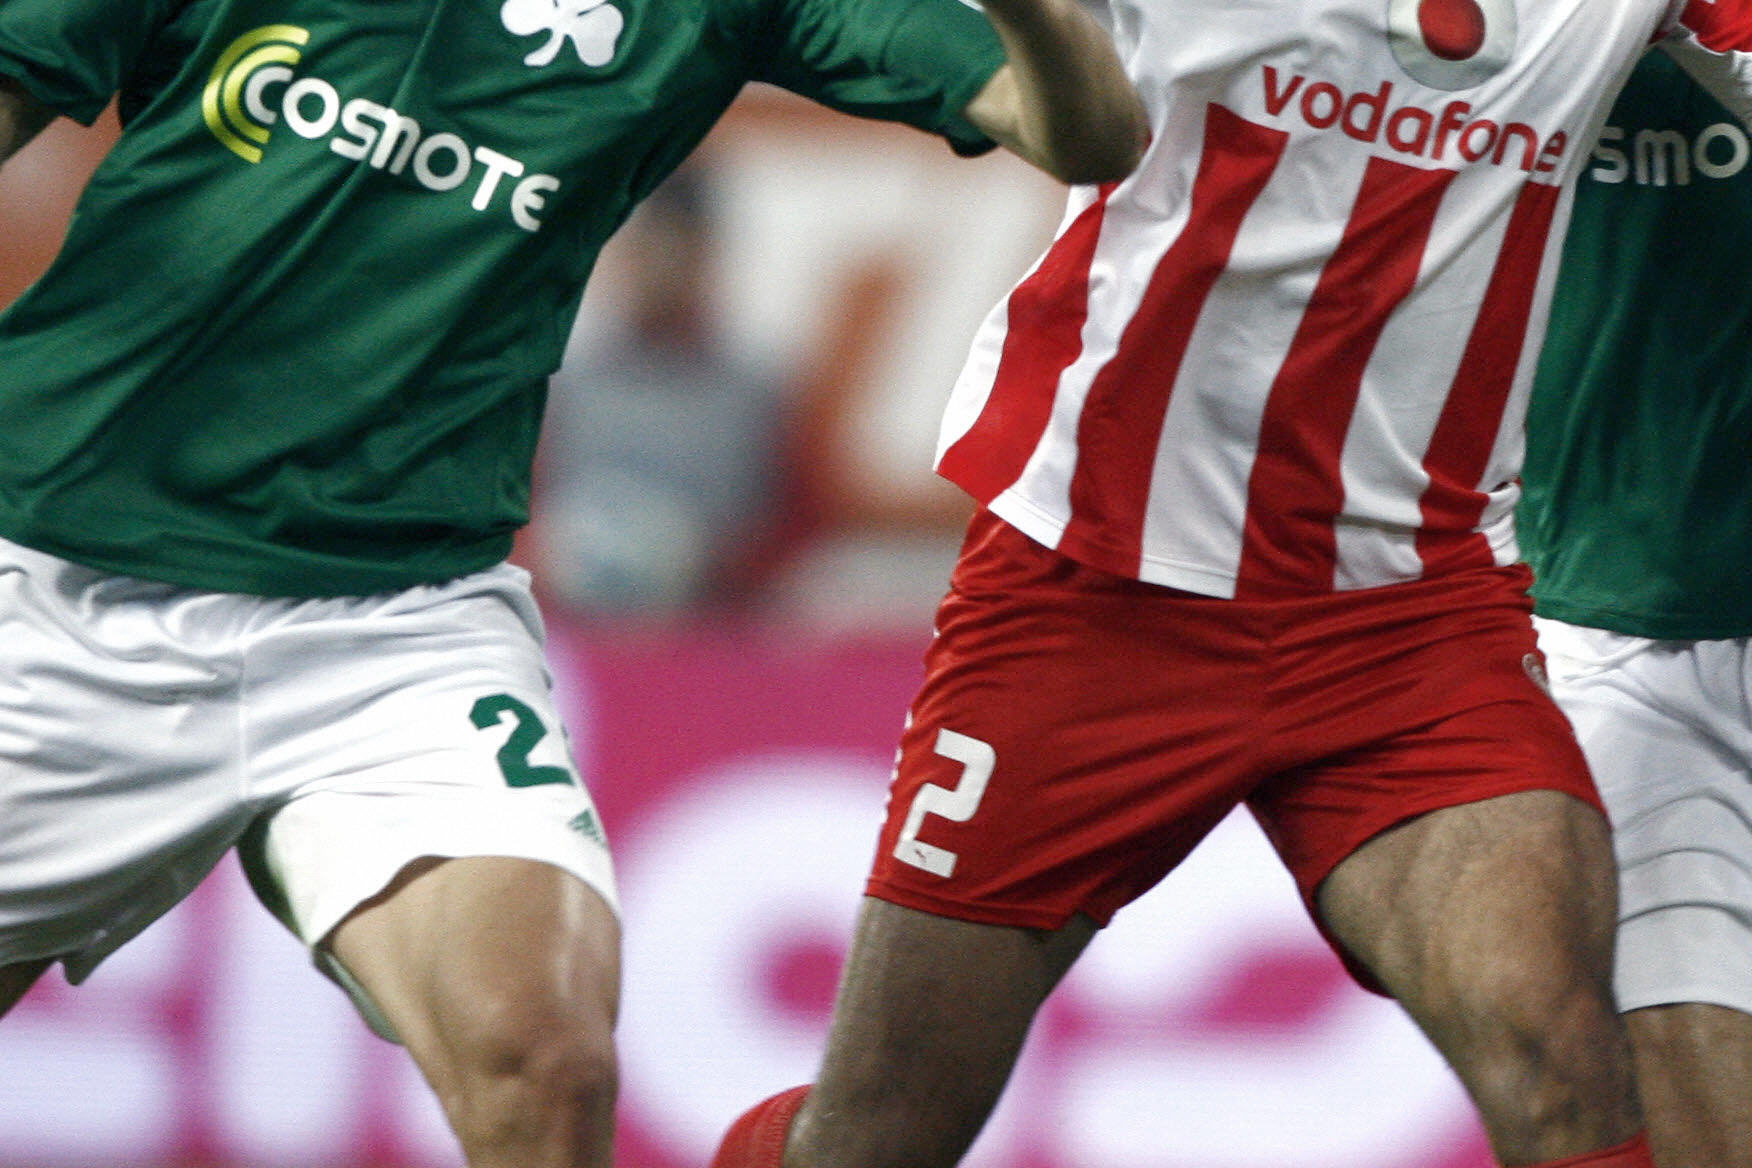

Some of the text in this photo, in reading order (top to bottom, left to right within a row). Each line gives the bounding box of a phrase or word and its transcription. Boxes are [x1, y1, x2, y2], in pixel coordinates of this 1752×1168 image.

[1263, 65, 1567, 173] vodafone
[469, 694, 574, 788] 2
[893, 727, 996, 879] 2
